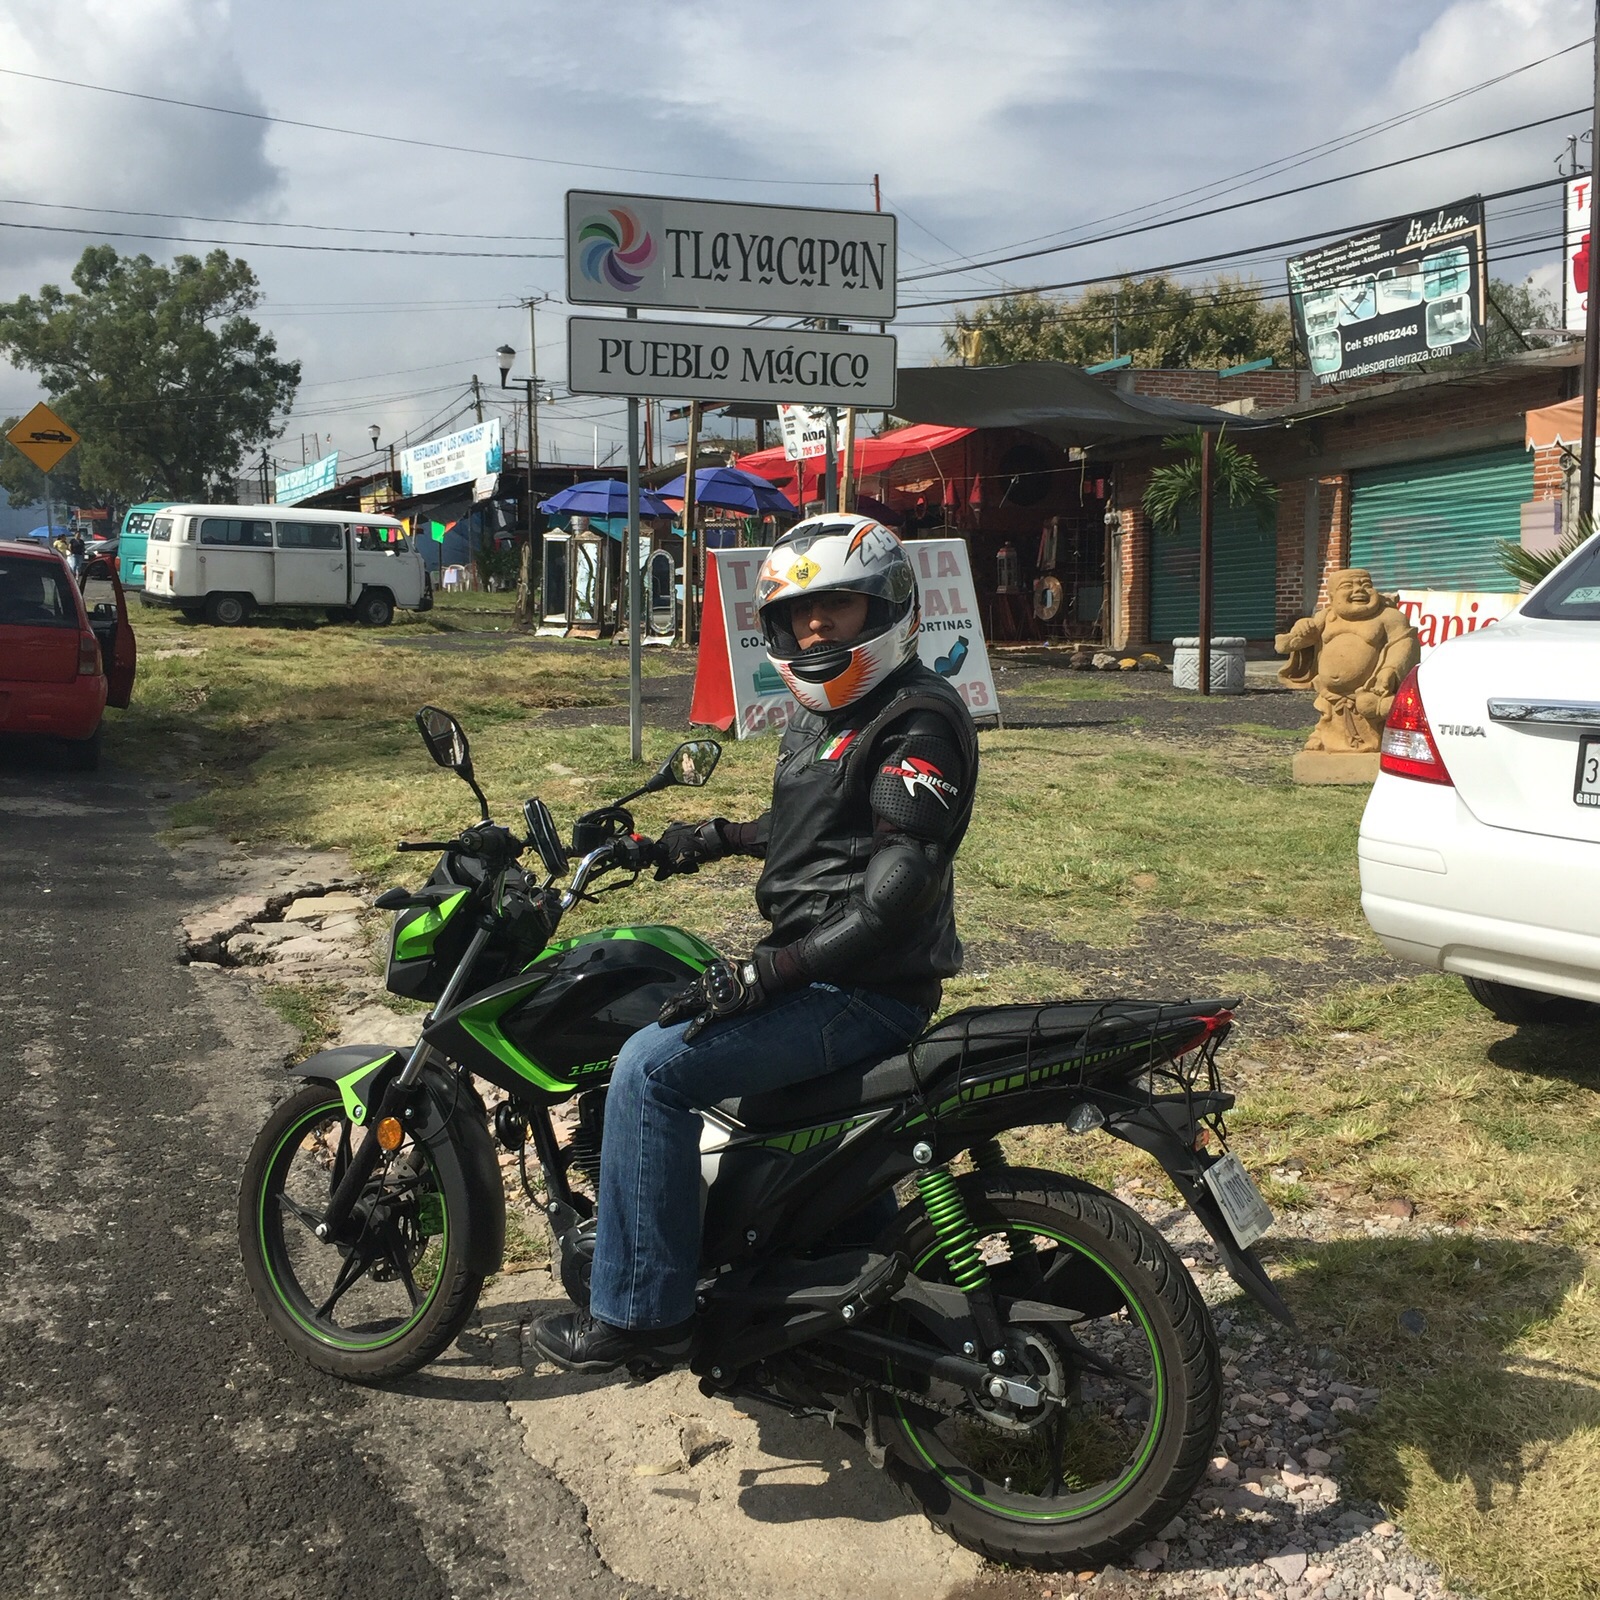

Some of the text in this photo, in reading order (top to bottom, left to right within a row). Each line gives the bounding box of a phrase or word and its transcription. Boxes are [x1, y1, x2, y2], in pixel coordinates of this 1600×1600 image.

[1345, 324, 1418, 352] Cel: 5510622443
[1438, 724, 1487, 738] TIIDA
